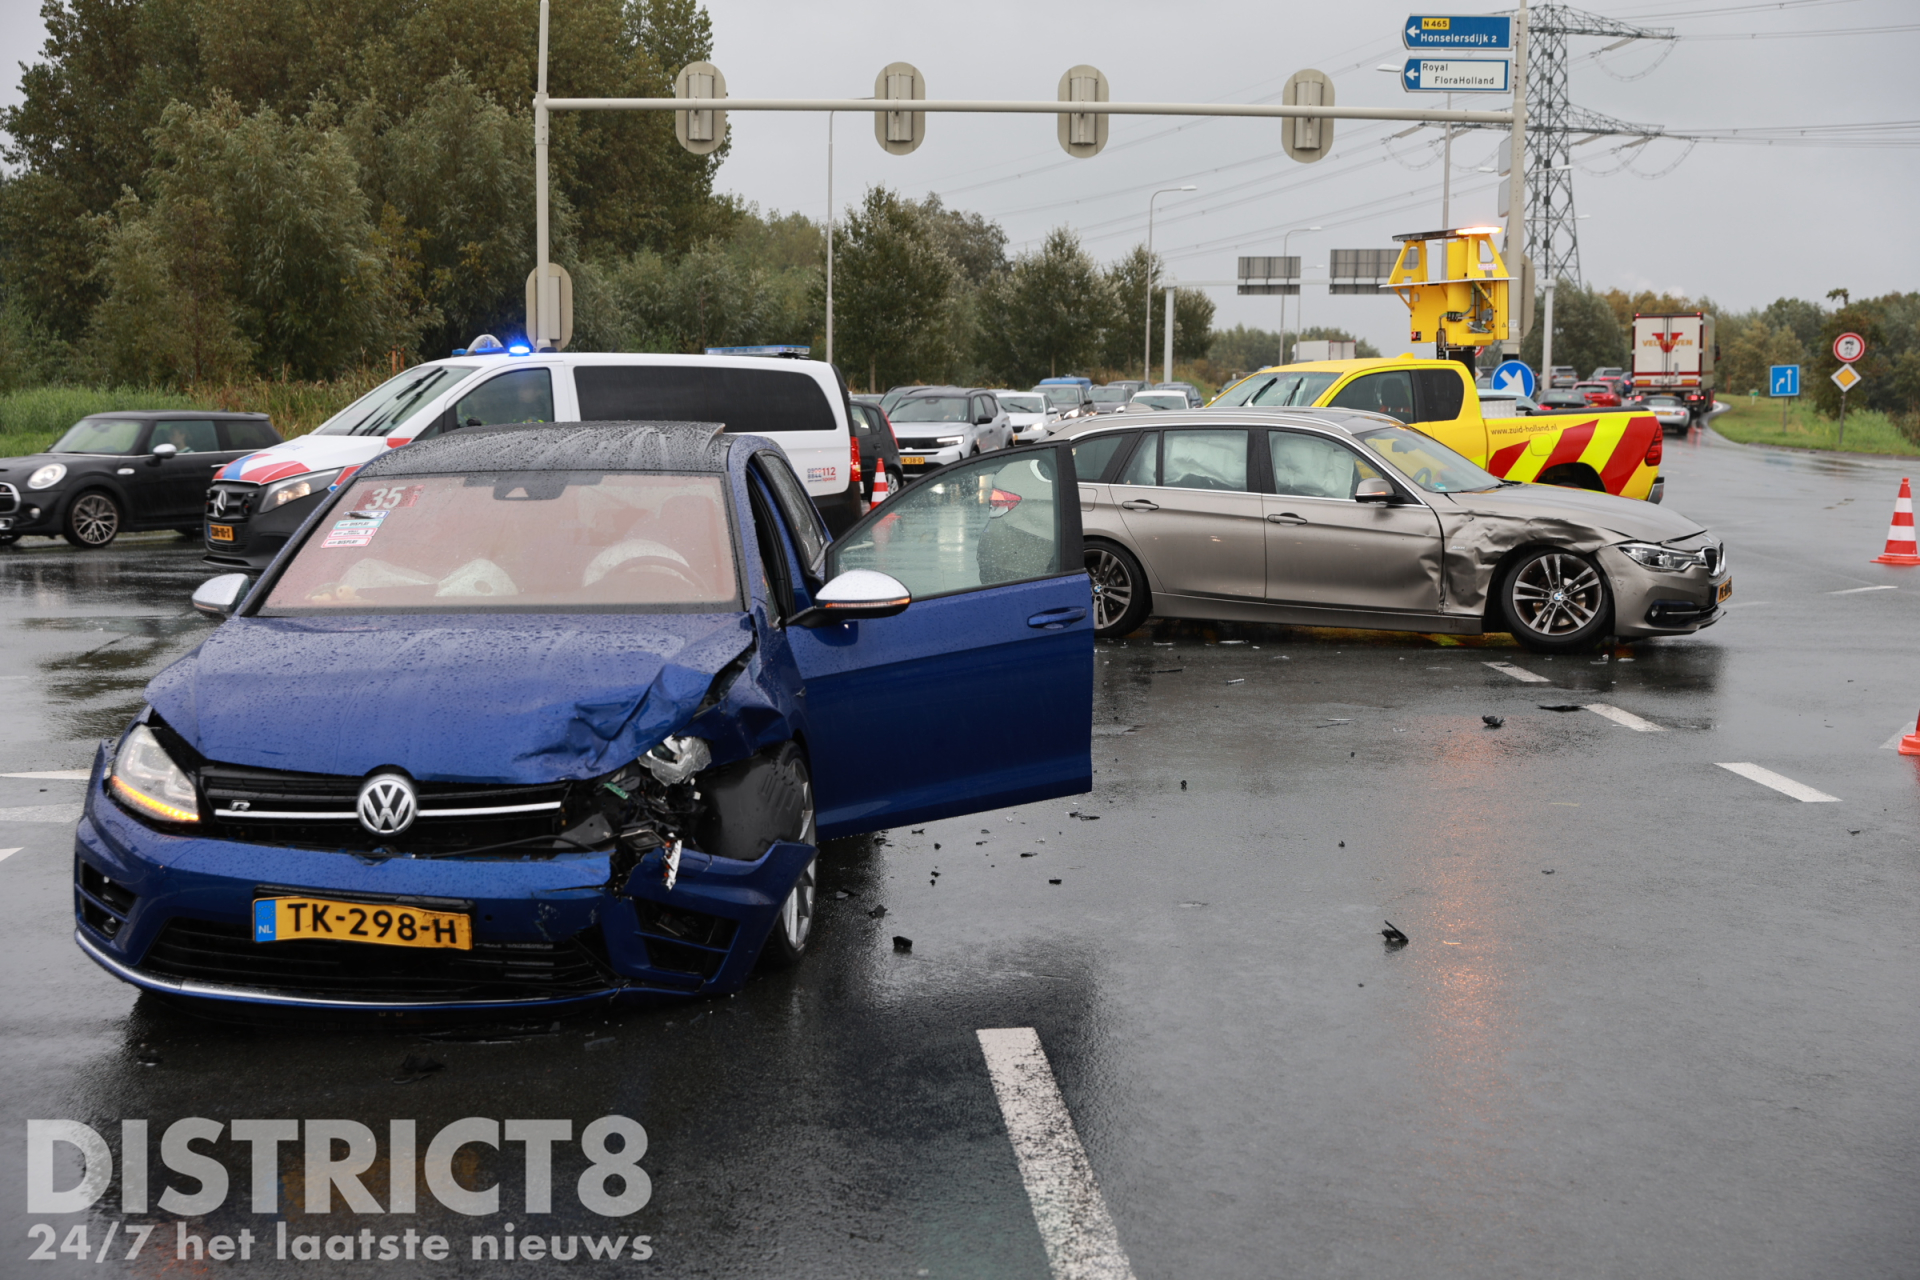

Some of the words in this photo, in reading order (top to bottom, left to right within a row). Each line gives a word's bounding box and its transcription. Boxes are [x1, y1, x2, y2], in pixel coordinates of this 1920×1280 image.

[1431, 20, 1448, 28] 465
[1420, 33, 1488, 45] Honselersdijk
[1491, 35, 1497, 43] 2
[1422, 63, 1448, 73] Royal
[1435, 76, 1494, 85] FloraHolland
[1491, 423, 1558, 435] www.zuid-holland.nl
[822, 467, 836, 476] 112
[365, 486, 406, 510] 35
[287, 903, 457, 943] TK-298-H
[258, 925, 273, 935] NL
